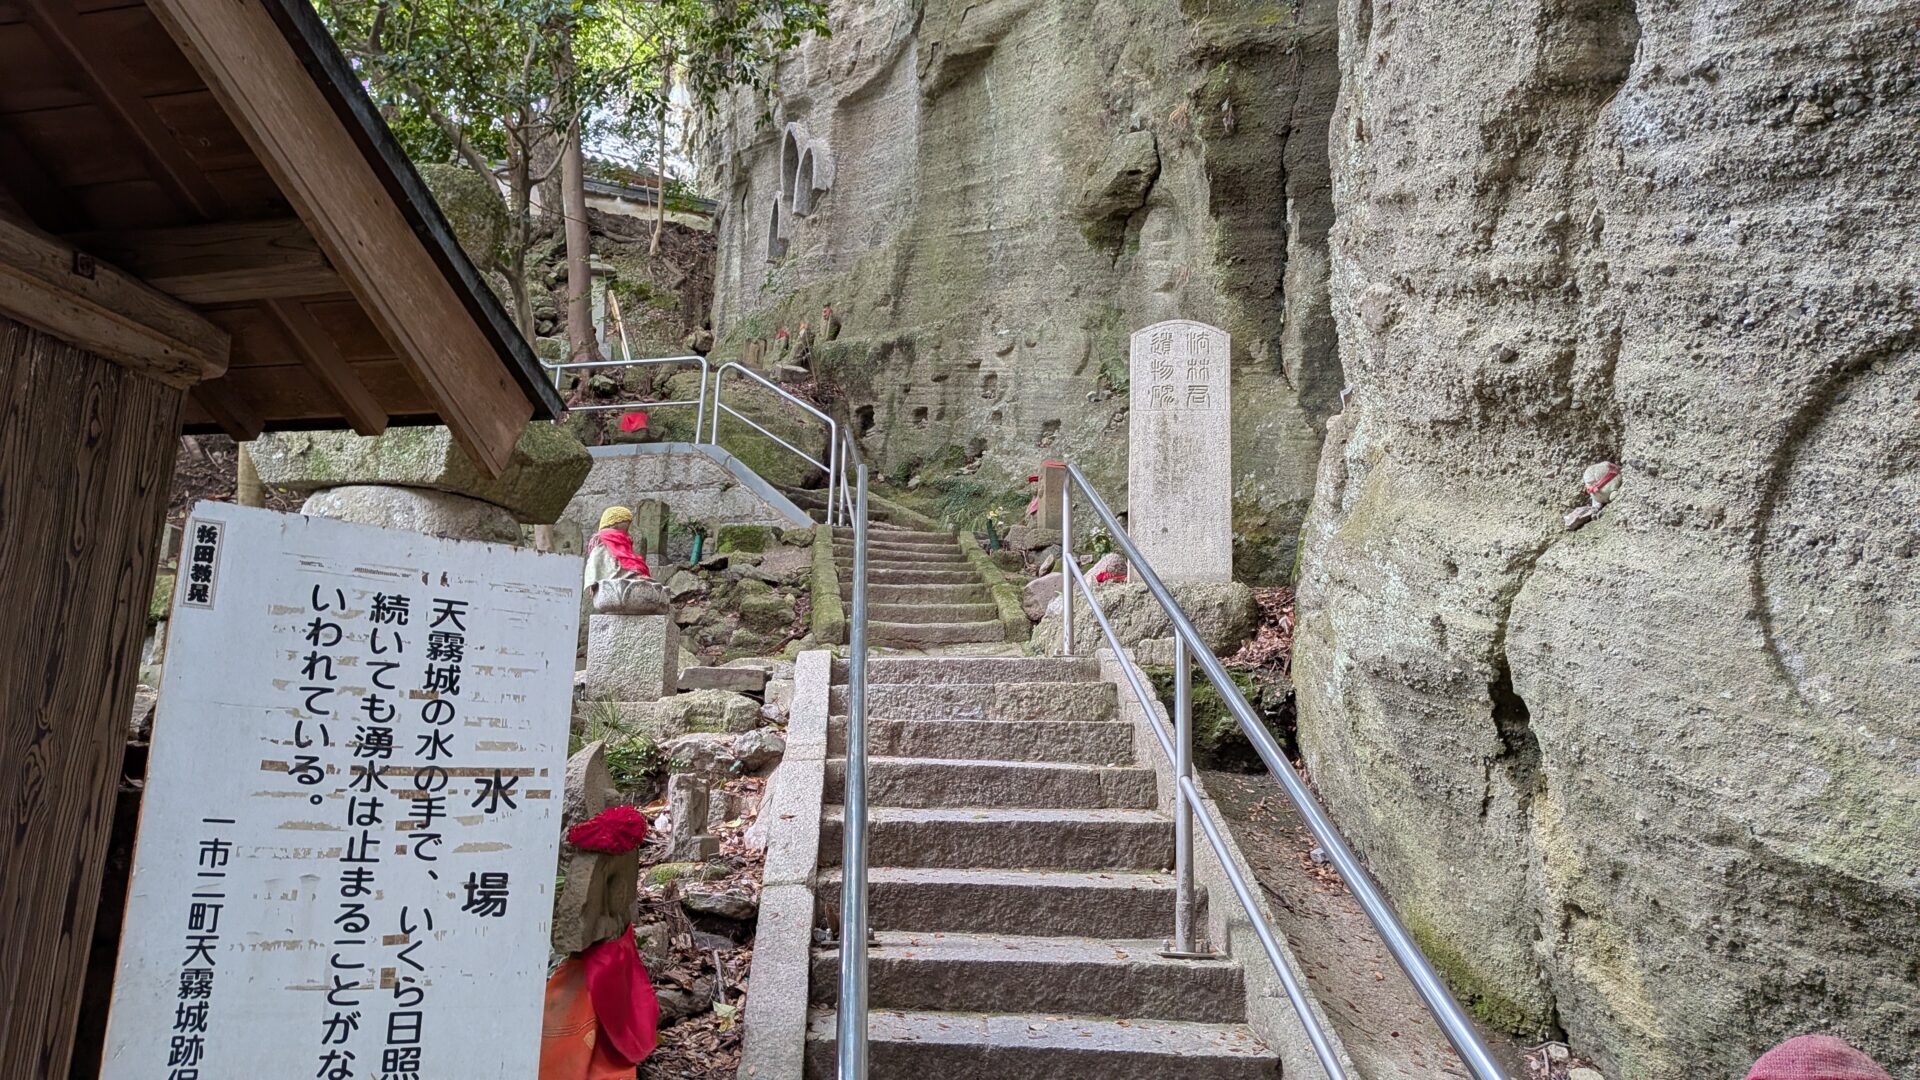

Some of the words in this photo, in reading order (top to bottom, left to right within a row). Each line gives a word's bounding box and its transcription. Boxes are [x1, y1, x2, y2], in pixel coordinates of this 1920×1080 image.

[288, 584, 346, 806] いわれている。
